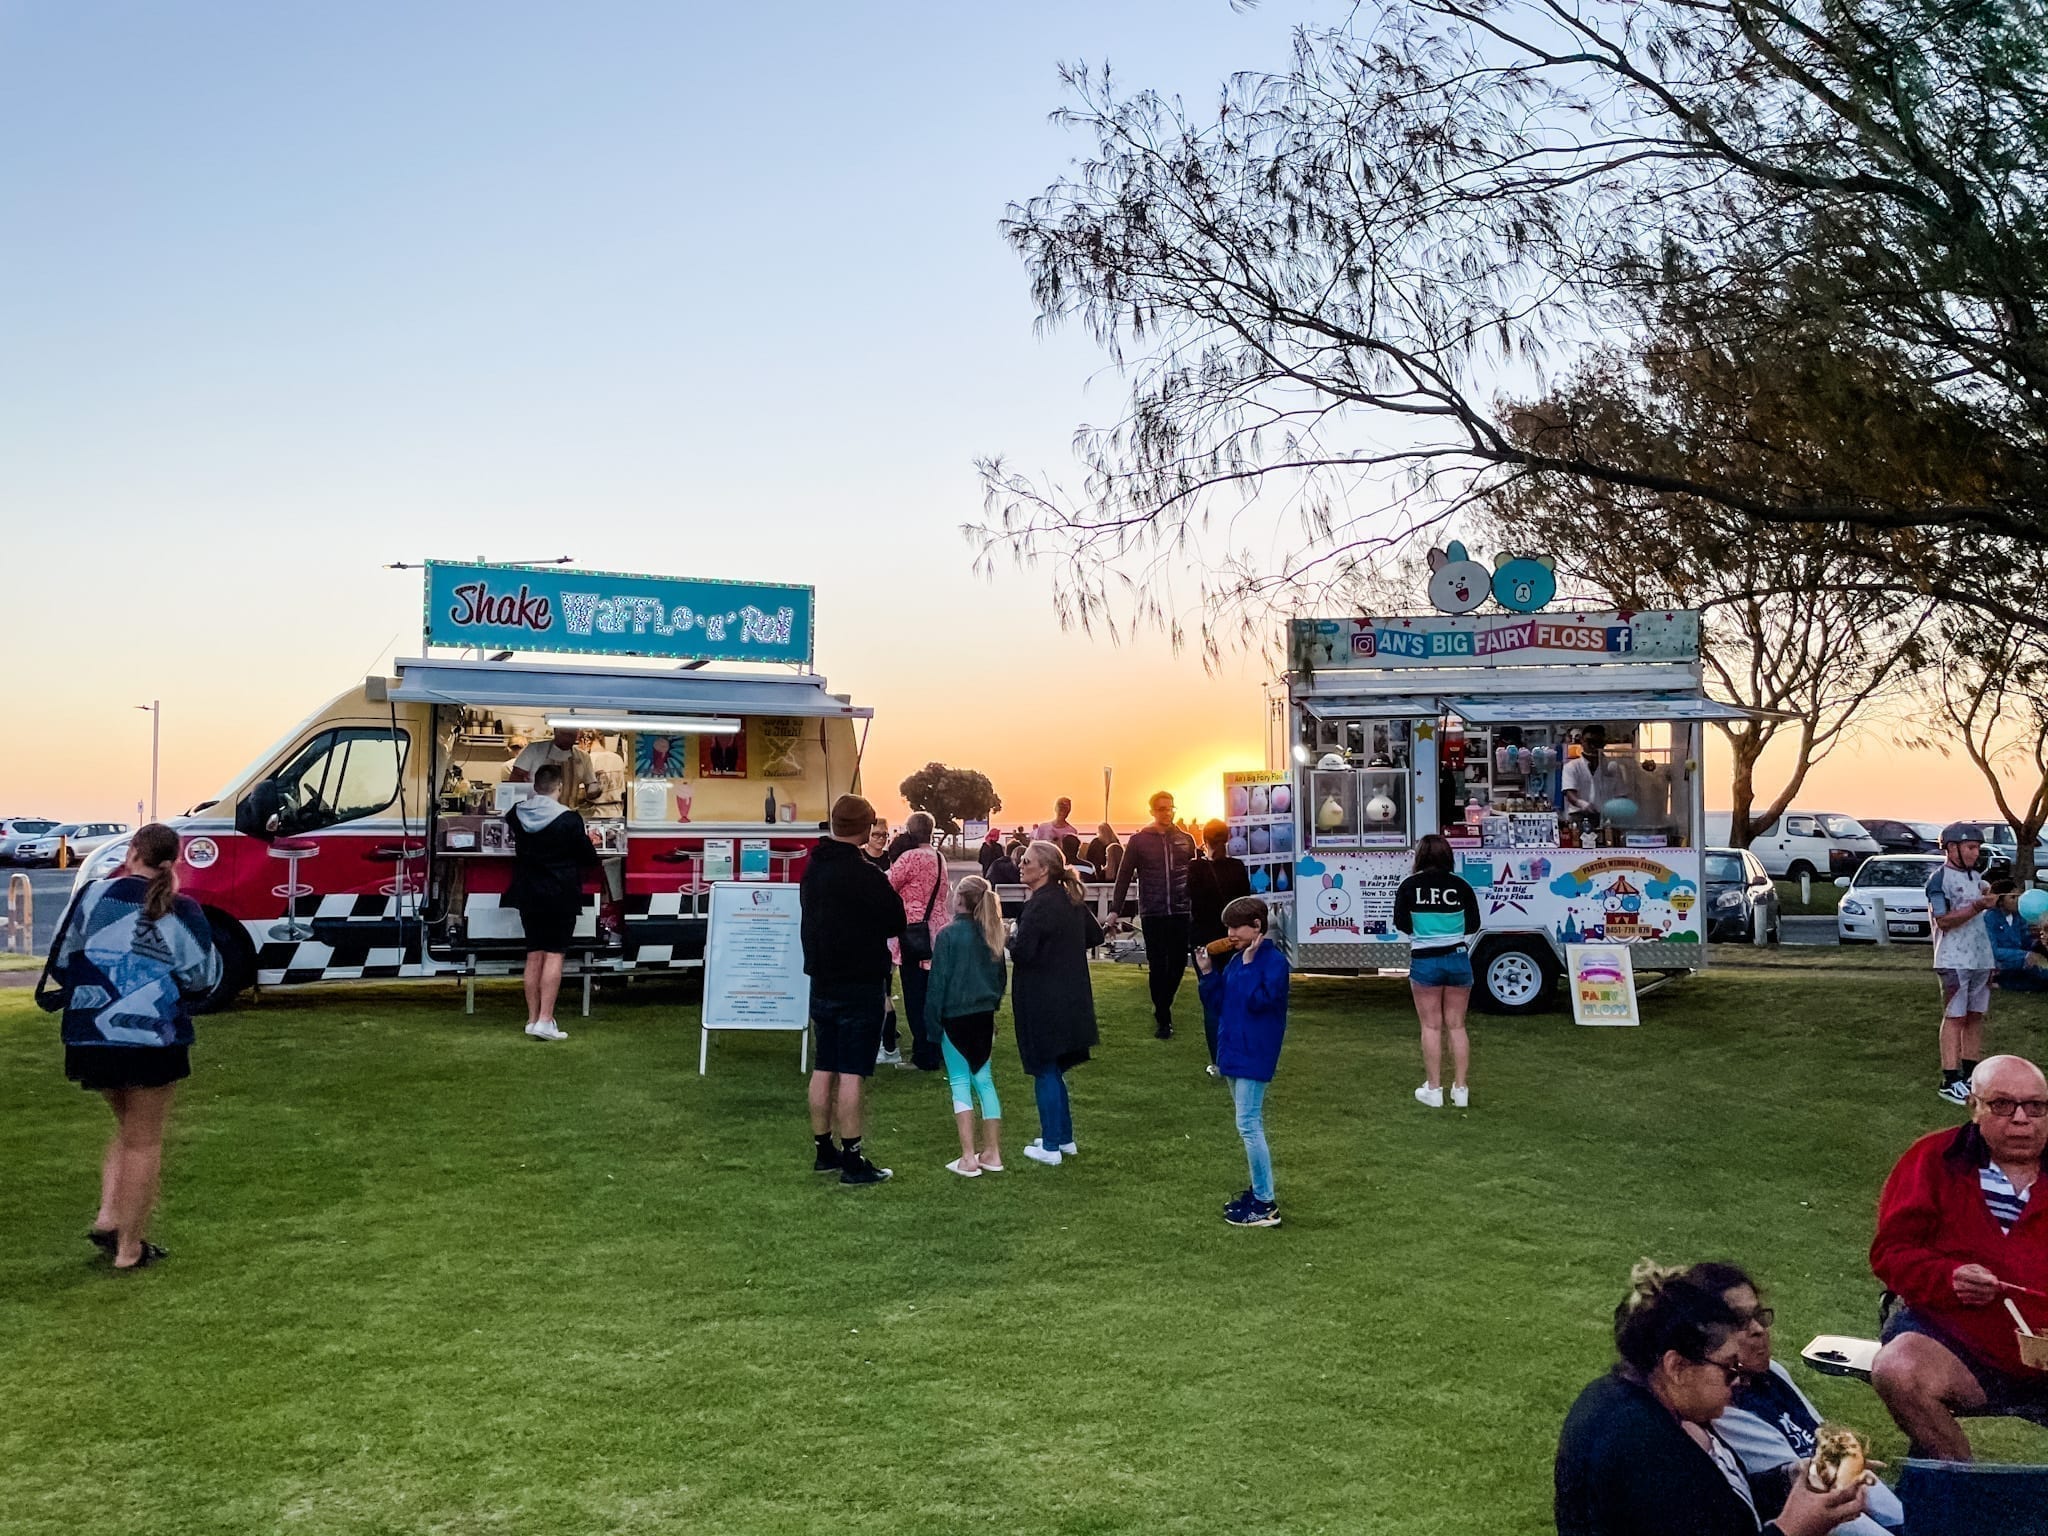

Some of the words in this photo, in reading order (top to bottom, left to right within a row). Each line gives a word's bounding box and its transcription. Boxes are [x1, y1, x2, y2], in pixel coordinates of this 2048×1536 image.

[451, 582, 552, 631] Shake
[739, 604, 794, 645] Roll
[1378, 632, 1425, 656] AN'S
[1432, 634, 1468, 653] BIG
[1474, 626, 1532, 653] FAIRY
[1538, 628, 1604, 649] FLOSS
[1512, 885, 1528, 894] Big
[1416, 888, 1460, 905] L.F.C.
[1485, 893, 1509, 901] Fairy
[1316, 917, 1354, 927] Rabbit
[1582, 990, 1618, 1000] FAIRY
[1584, 1004, 1628, 1015] FLOSS
